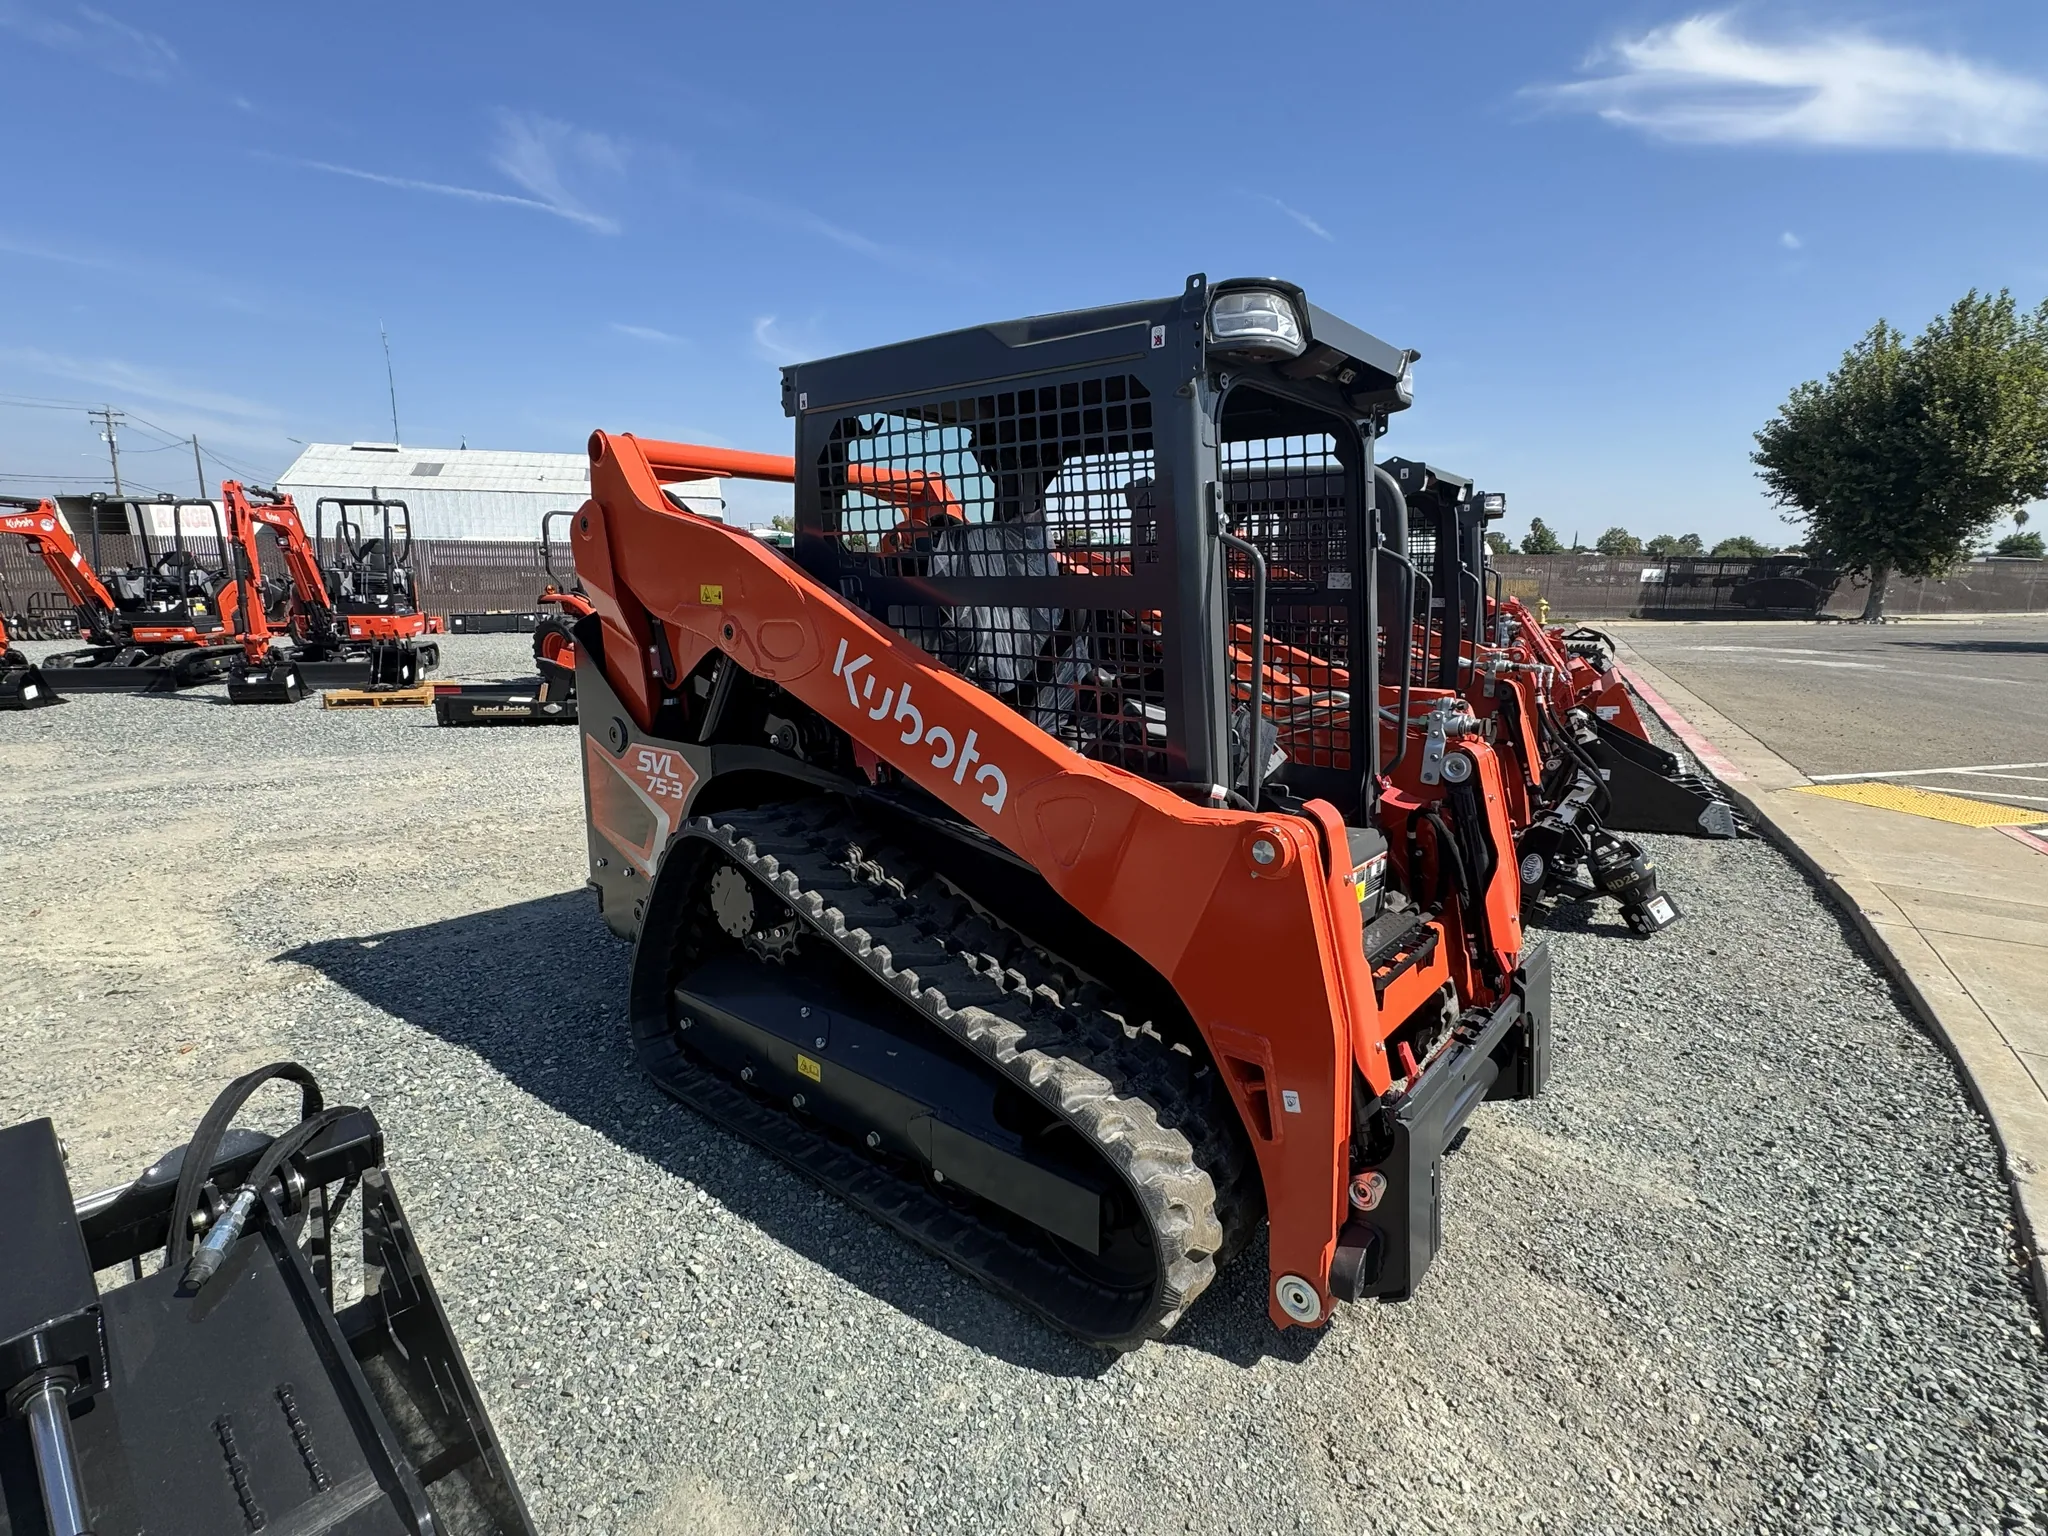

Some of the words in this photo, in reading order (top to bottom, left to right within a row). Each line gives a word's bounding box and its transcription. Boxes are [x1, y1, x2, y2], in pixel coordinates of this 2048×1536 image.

[833, 637, 1008, 815] Kubota
[637, 750, 679, 779] SVL
[646, 775, 683, 799] 75-3
[1607, 872, 1640, 891] HD25
